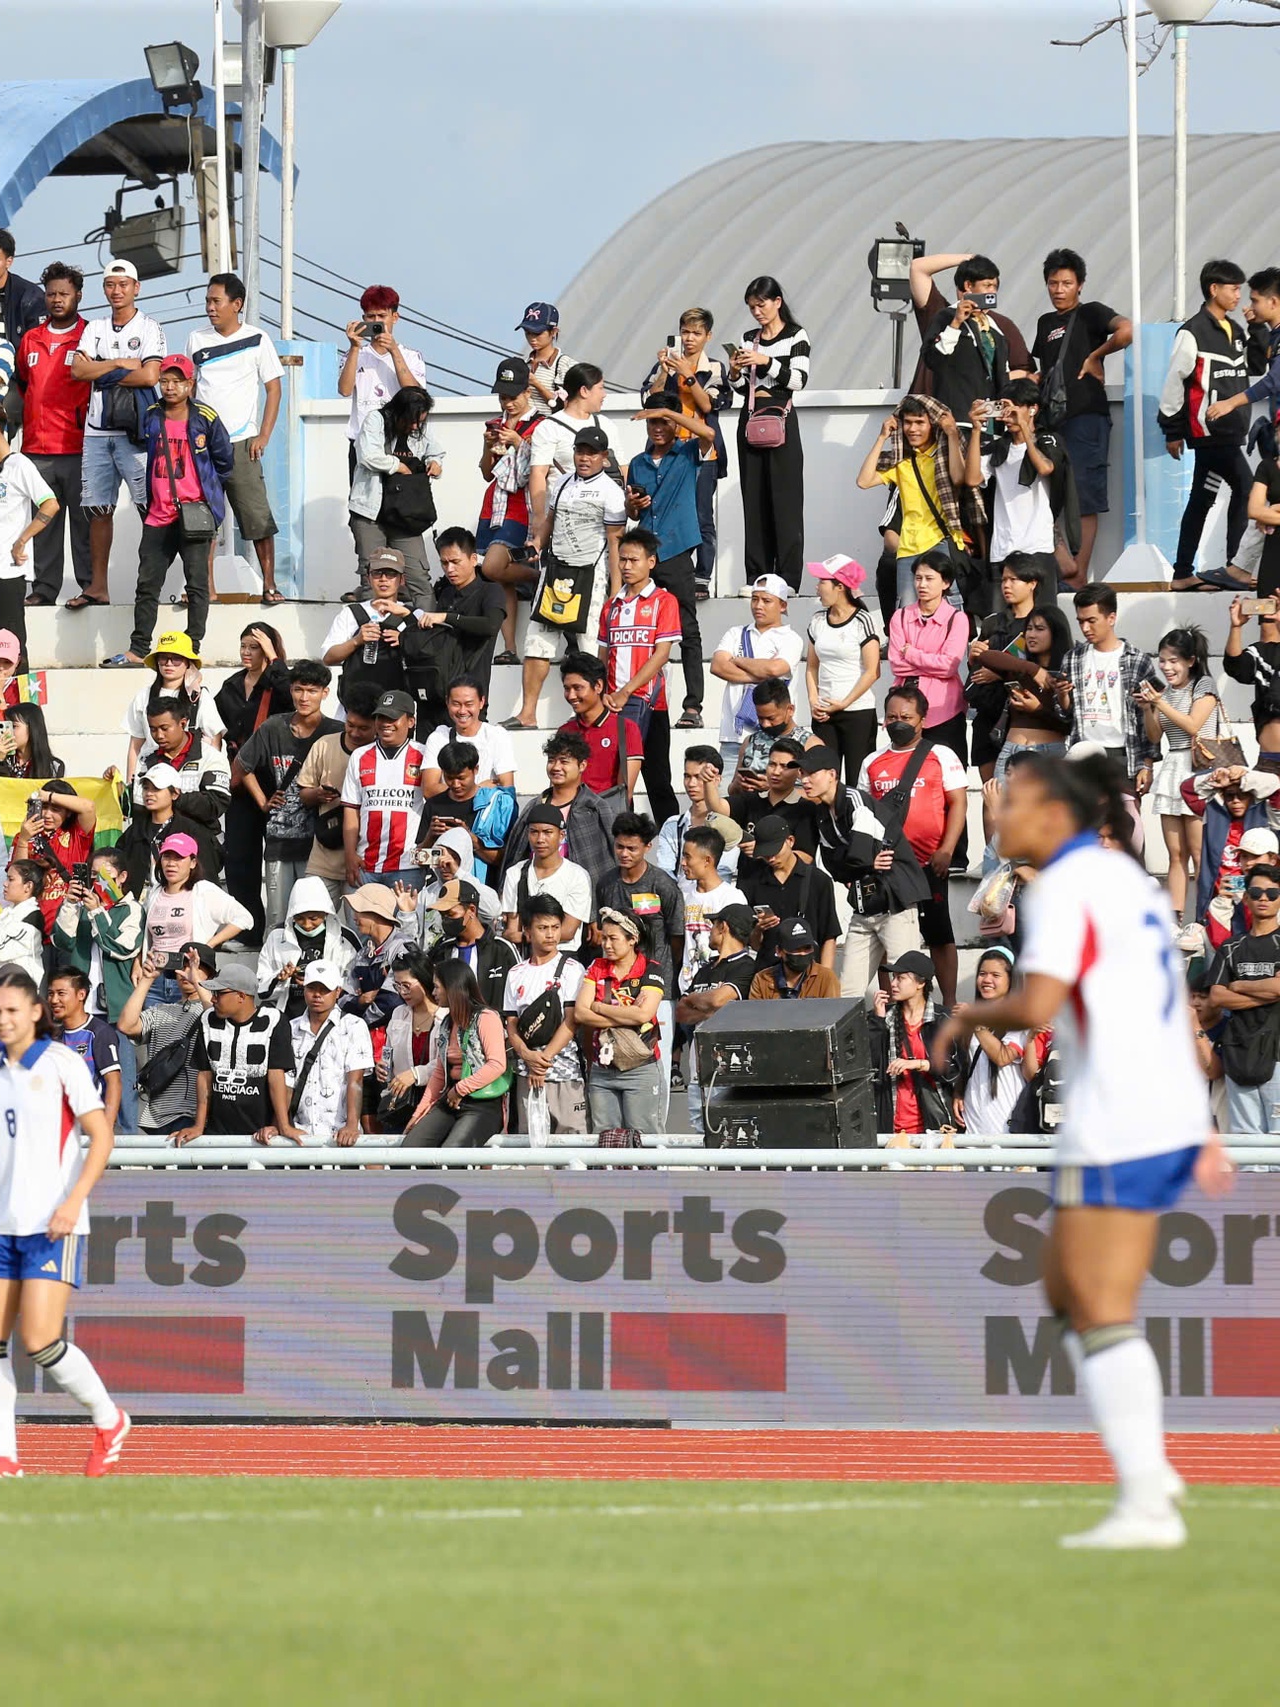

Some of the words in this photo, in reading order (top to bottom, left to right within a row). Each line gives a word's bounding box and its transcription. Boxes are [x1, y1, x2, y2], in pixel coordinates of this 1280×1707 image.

[615, 631, 634, 642] PICK
[637, 630, 649, 642] FC
[109, 1044, 119, 1062] 1
[5, 1108, 17, 1139] 8
[388, 1183, 788, 1304] Sports
[979, 1187, 1280, 1287] Sor
[391, 1311, 604, 1390] Mall
[985, 1316, 1205, 1397] Mll
